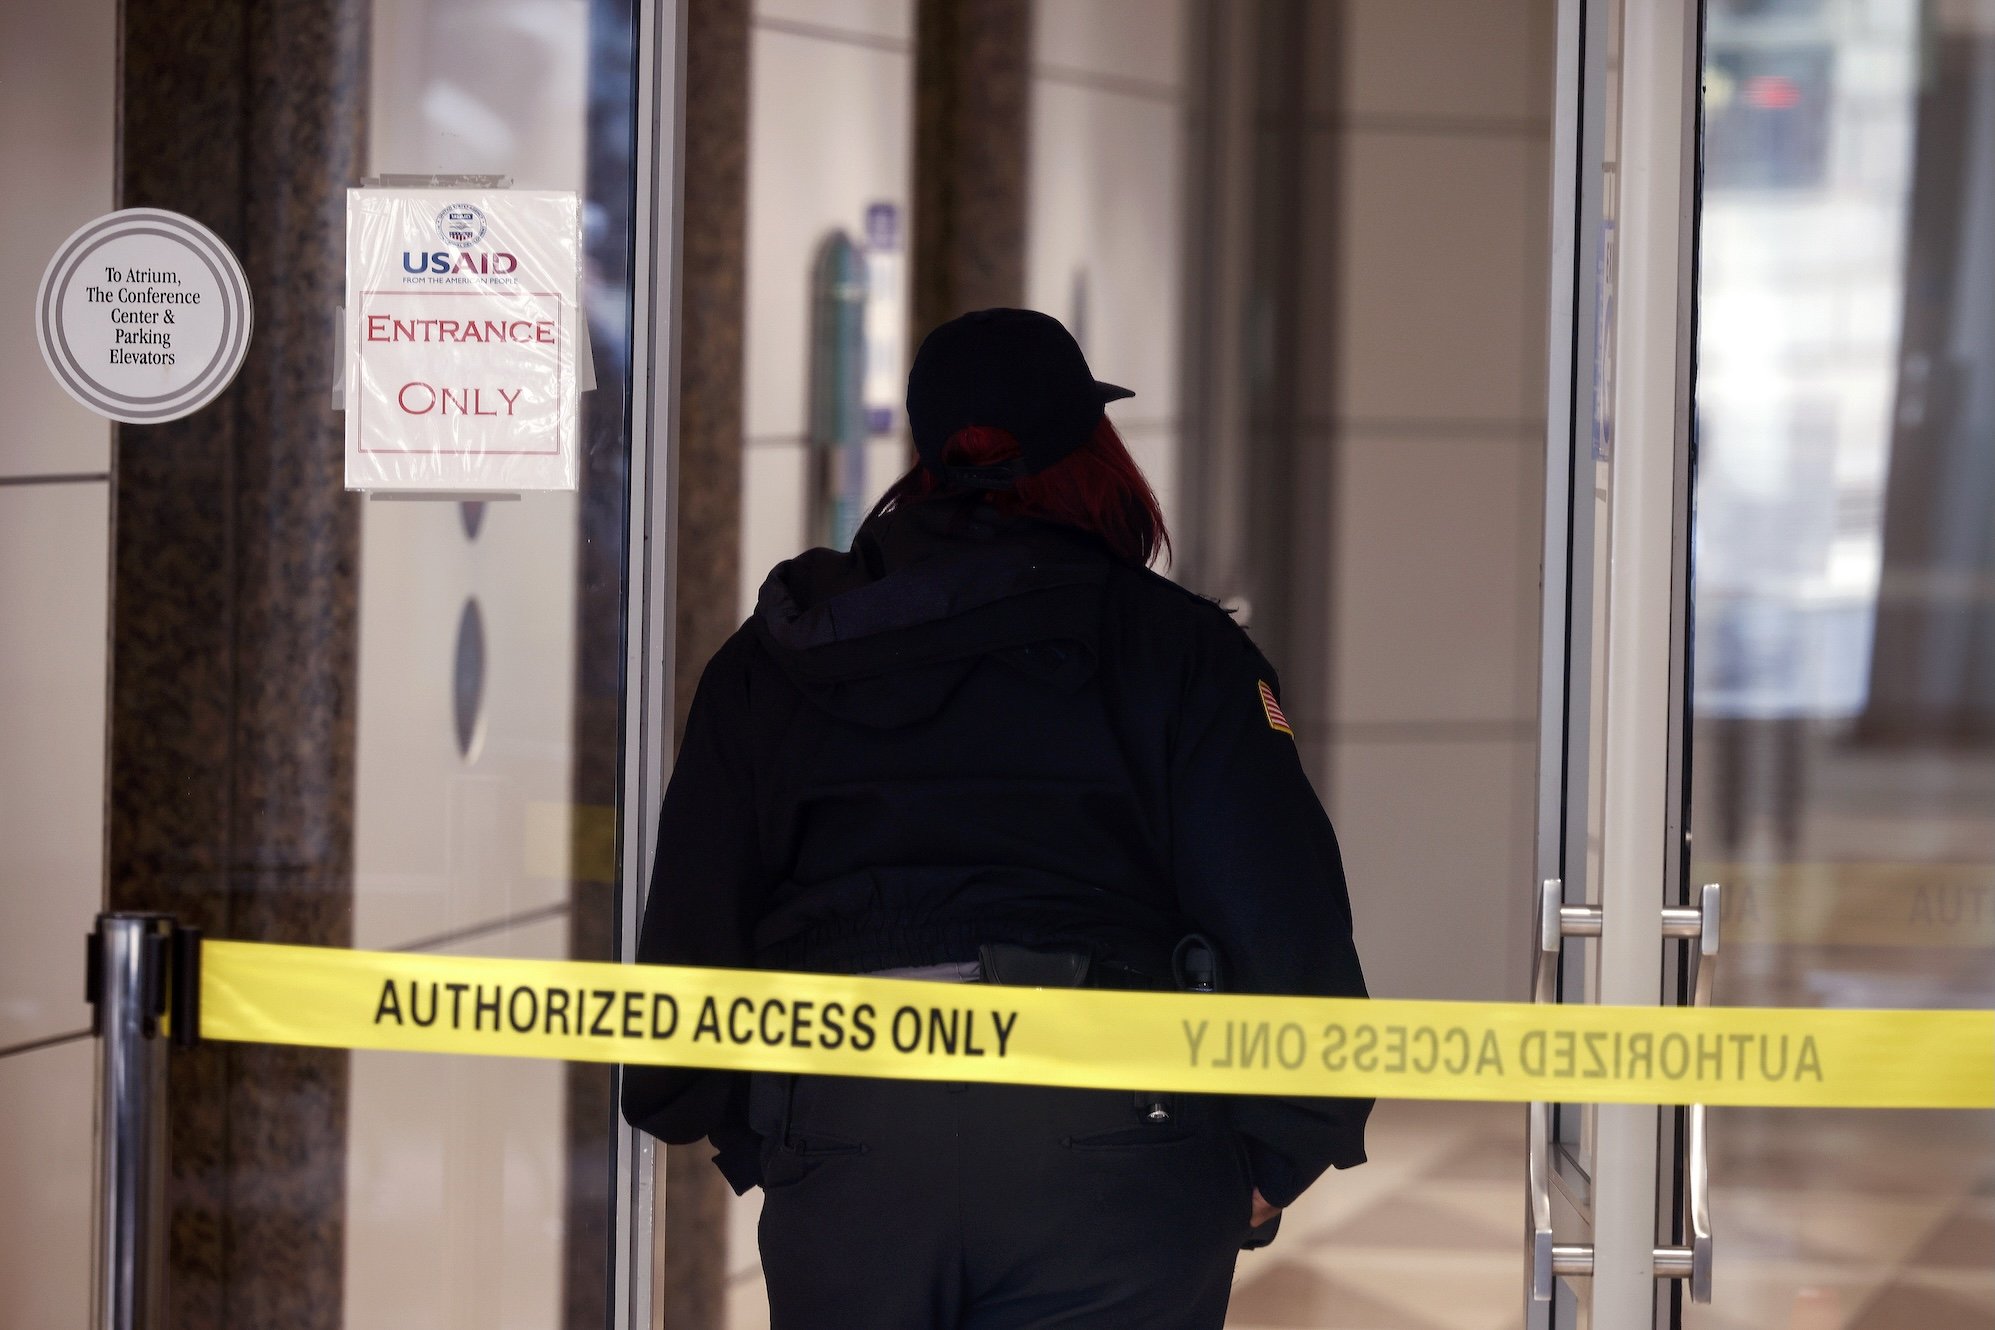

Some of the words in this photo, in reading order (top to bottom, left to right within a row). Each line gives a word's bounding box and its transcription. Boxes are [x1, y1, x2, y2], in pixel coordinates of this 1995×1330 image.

[403, 252, 517, 274] USAID
[105, 267, 122, 282] To
[126, 268, 181, 286] Atrium,
[490, 277, 519, 285] PEOPLE
[86, 286, 113, 303] The
[118, 287, 201, 304] Conference
[111, 308, 159, 323] Center
[163, 309, 175, 324] &
[115, 328, 171, 349] Parking
[367, 314, 555, 344] ENTRANCE
[110, 348, 175, 365] Elevators
[398, 382, 522, 416] ONLY
[374, 979, 679, 1041] AUTHORIZED
[693, 996, 876, 1052] ACCESS
[892, 1005, 1018, 1058] ONLY
